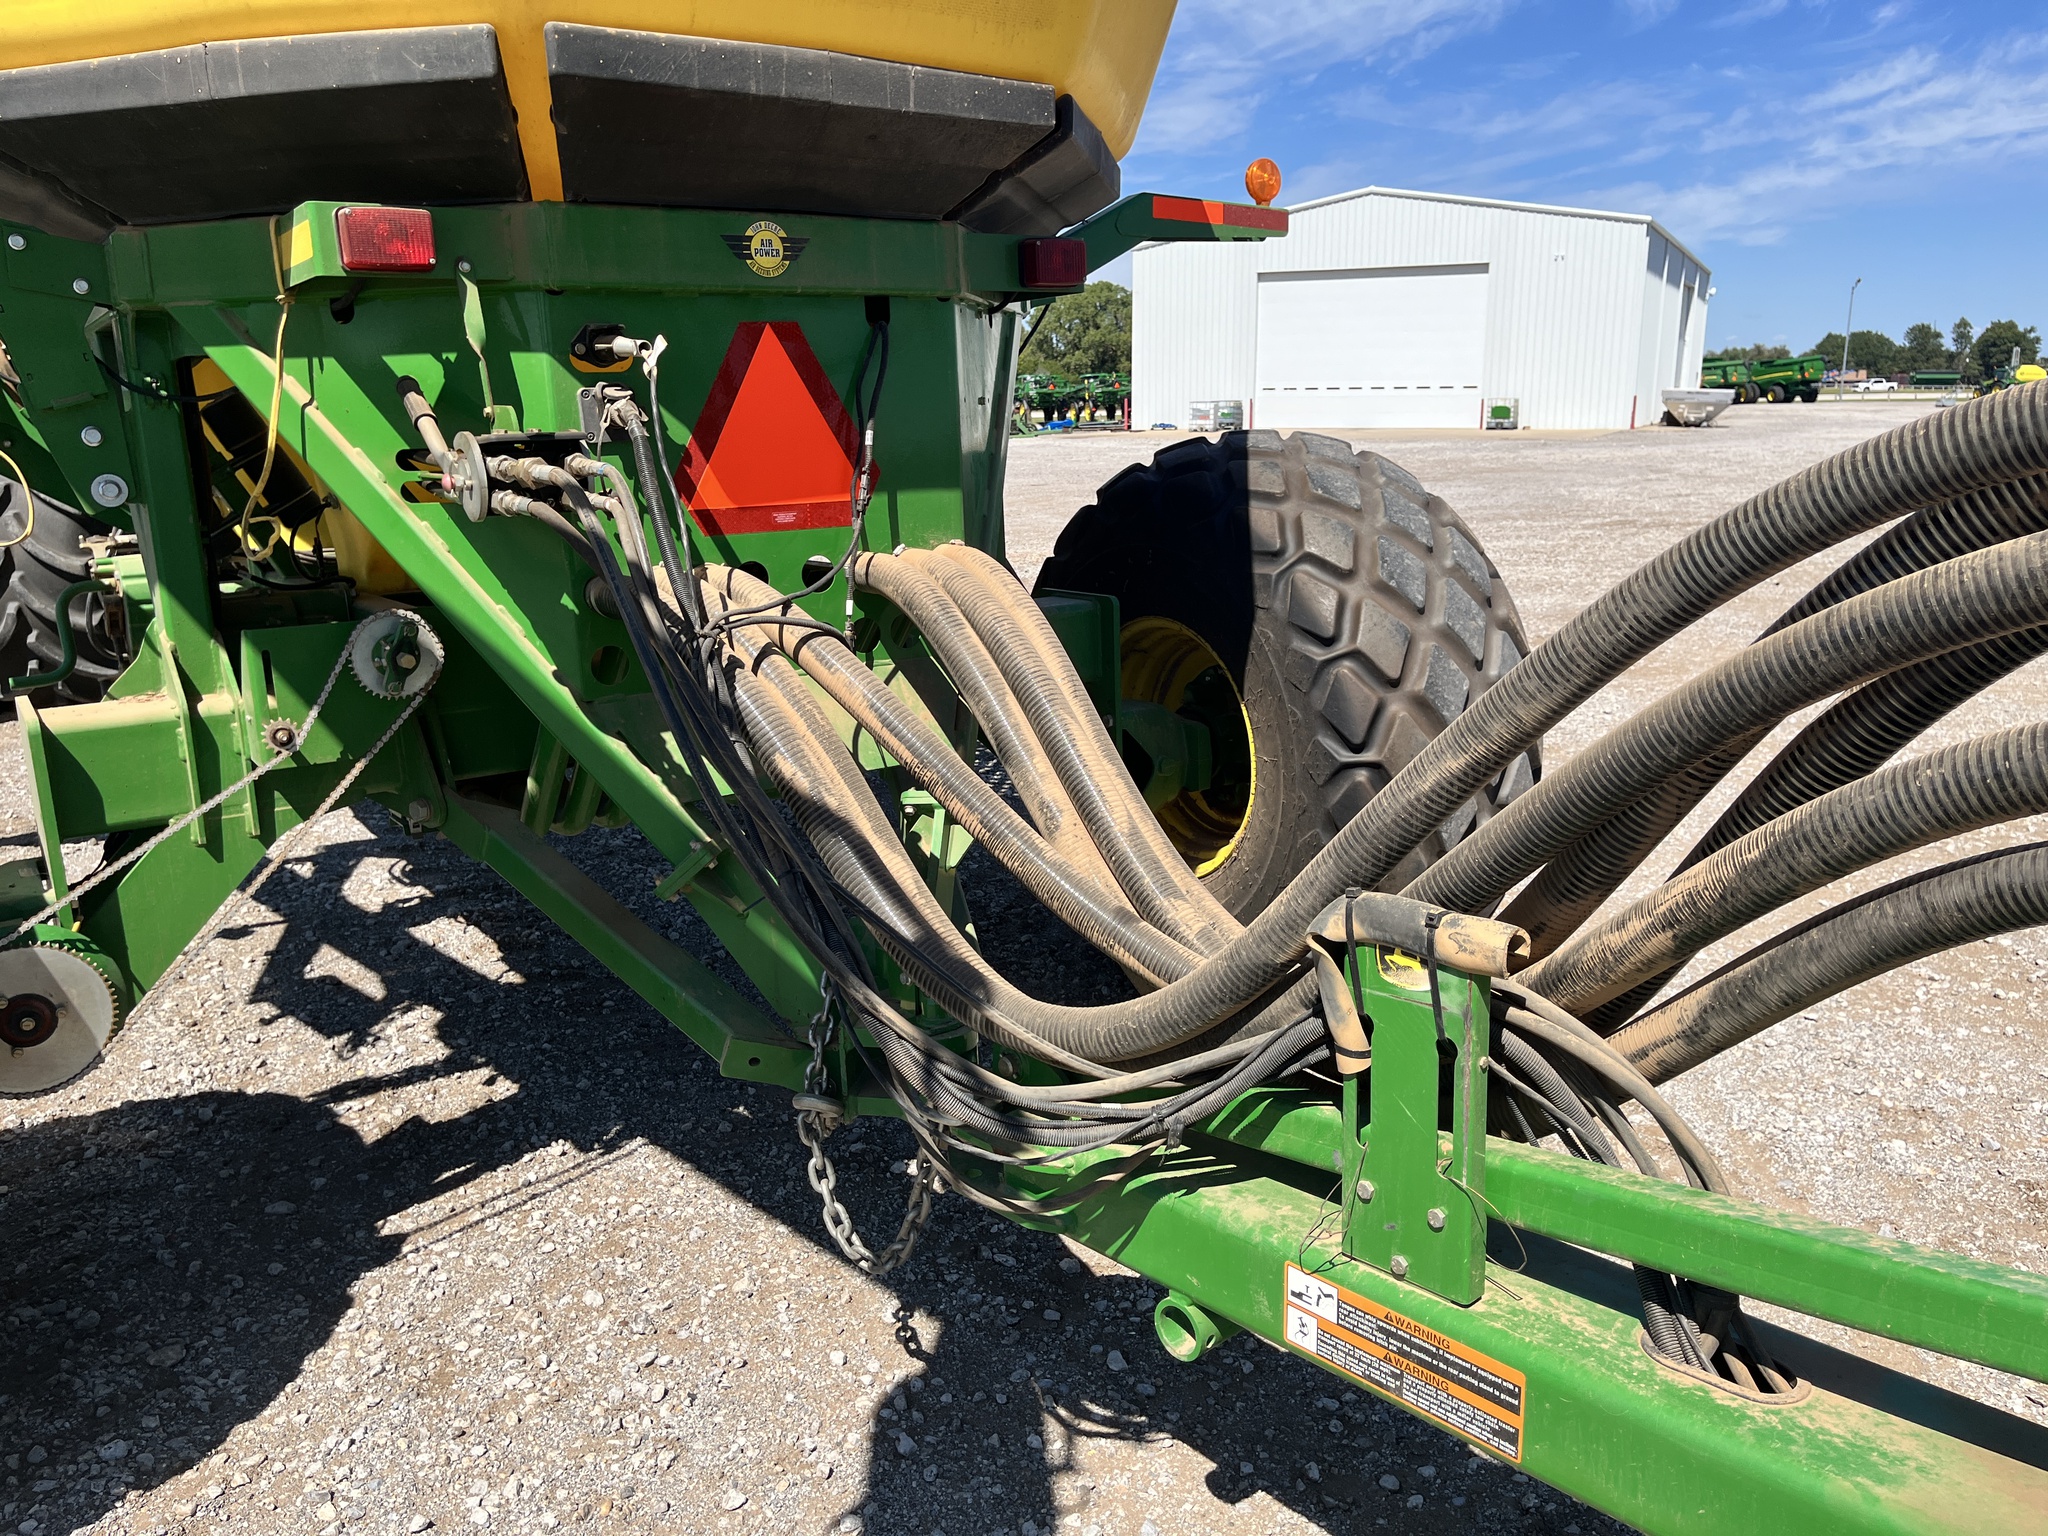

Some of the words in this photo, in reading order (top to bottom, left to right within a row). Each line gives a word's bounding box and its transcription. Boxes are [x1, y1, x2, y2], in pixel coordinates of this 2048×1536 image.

[750, 222, 762, 233] JOHN
[764, 222, 782, 234] DEERE
[760, 238, 773, 248] AIR
[754, 248, 780, 258] POWER
[1394, 1315, 1449, 1350] WARNING
[1393, 1356, 1448, 1392] WARNING
